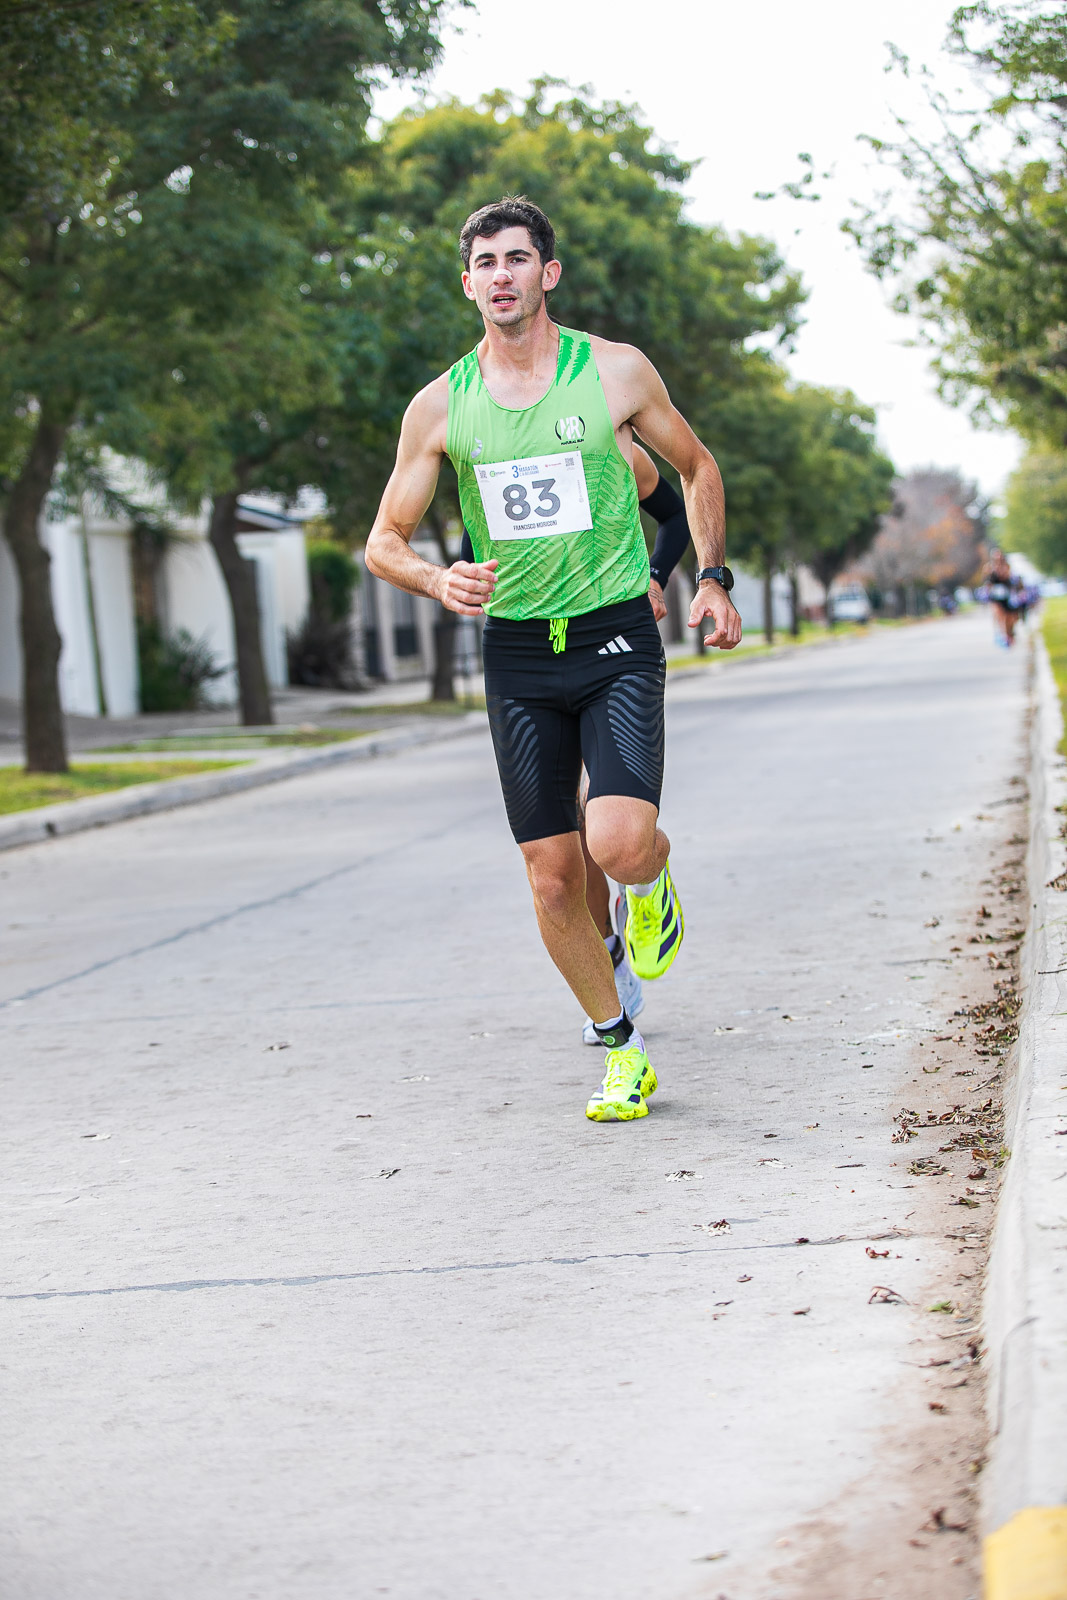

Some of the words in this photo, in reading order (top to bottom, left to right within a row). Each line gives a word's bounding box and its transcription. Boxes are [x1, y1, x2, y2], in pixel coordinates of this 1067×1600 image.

[502, 478, 560, 521] 83
[513, 523, 536, 531] FRANCISCO
[536, 520, 558, 528] MORICONI
